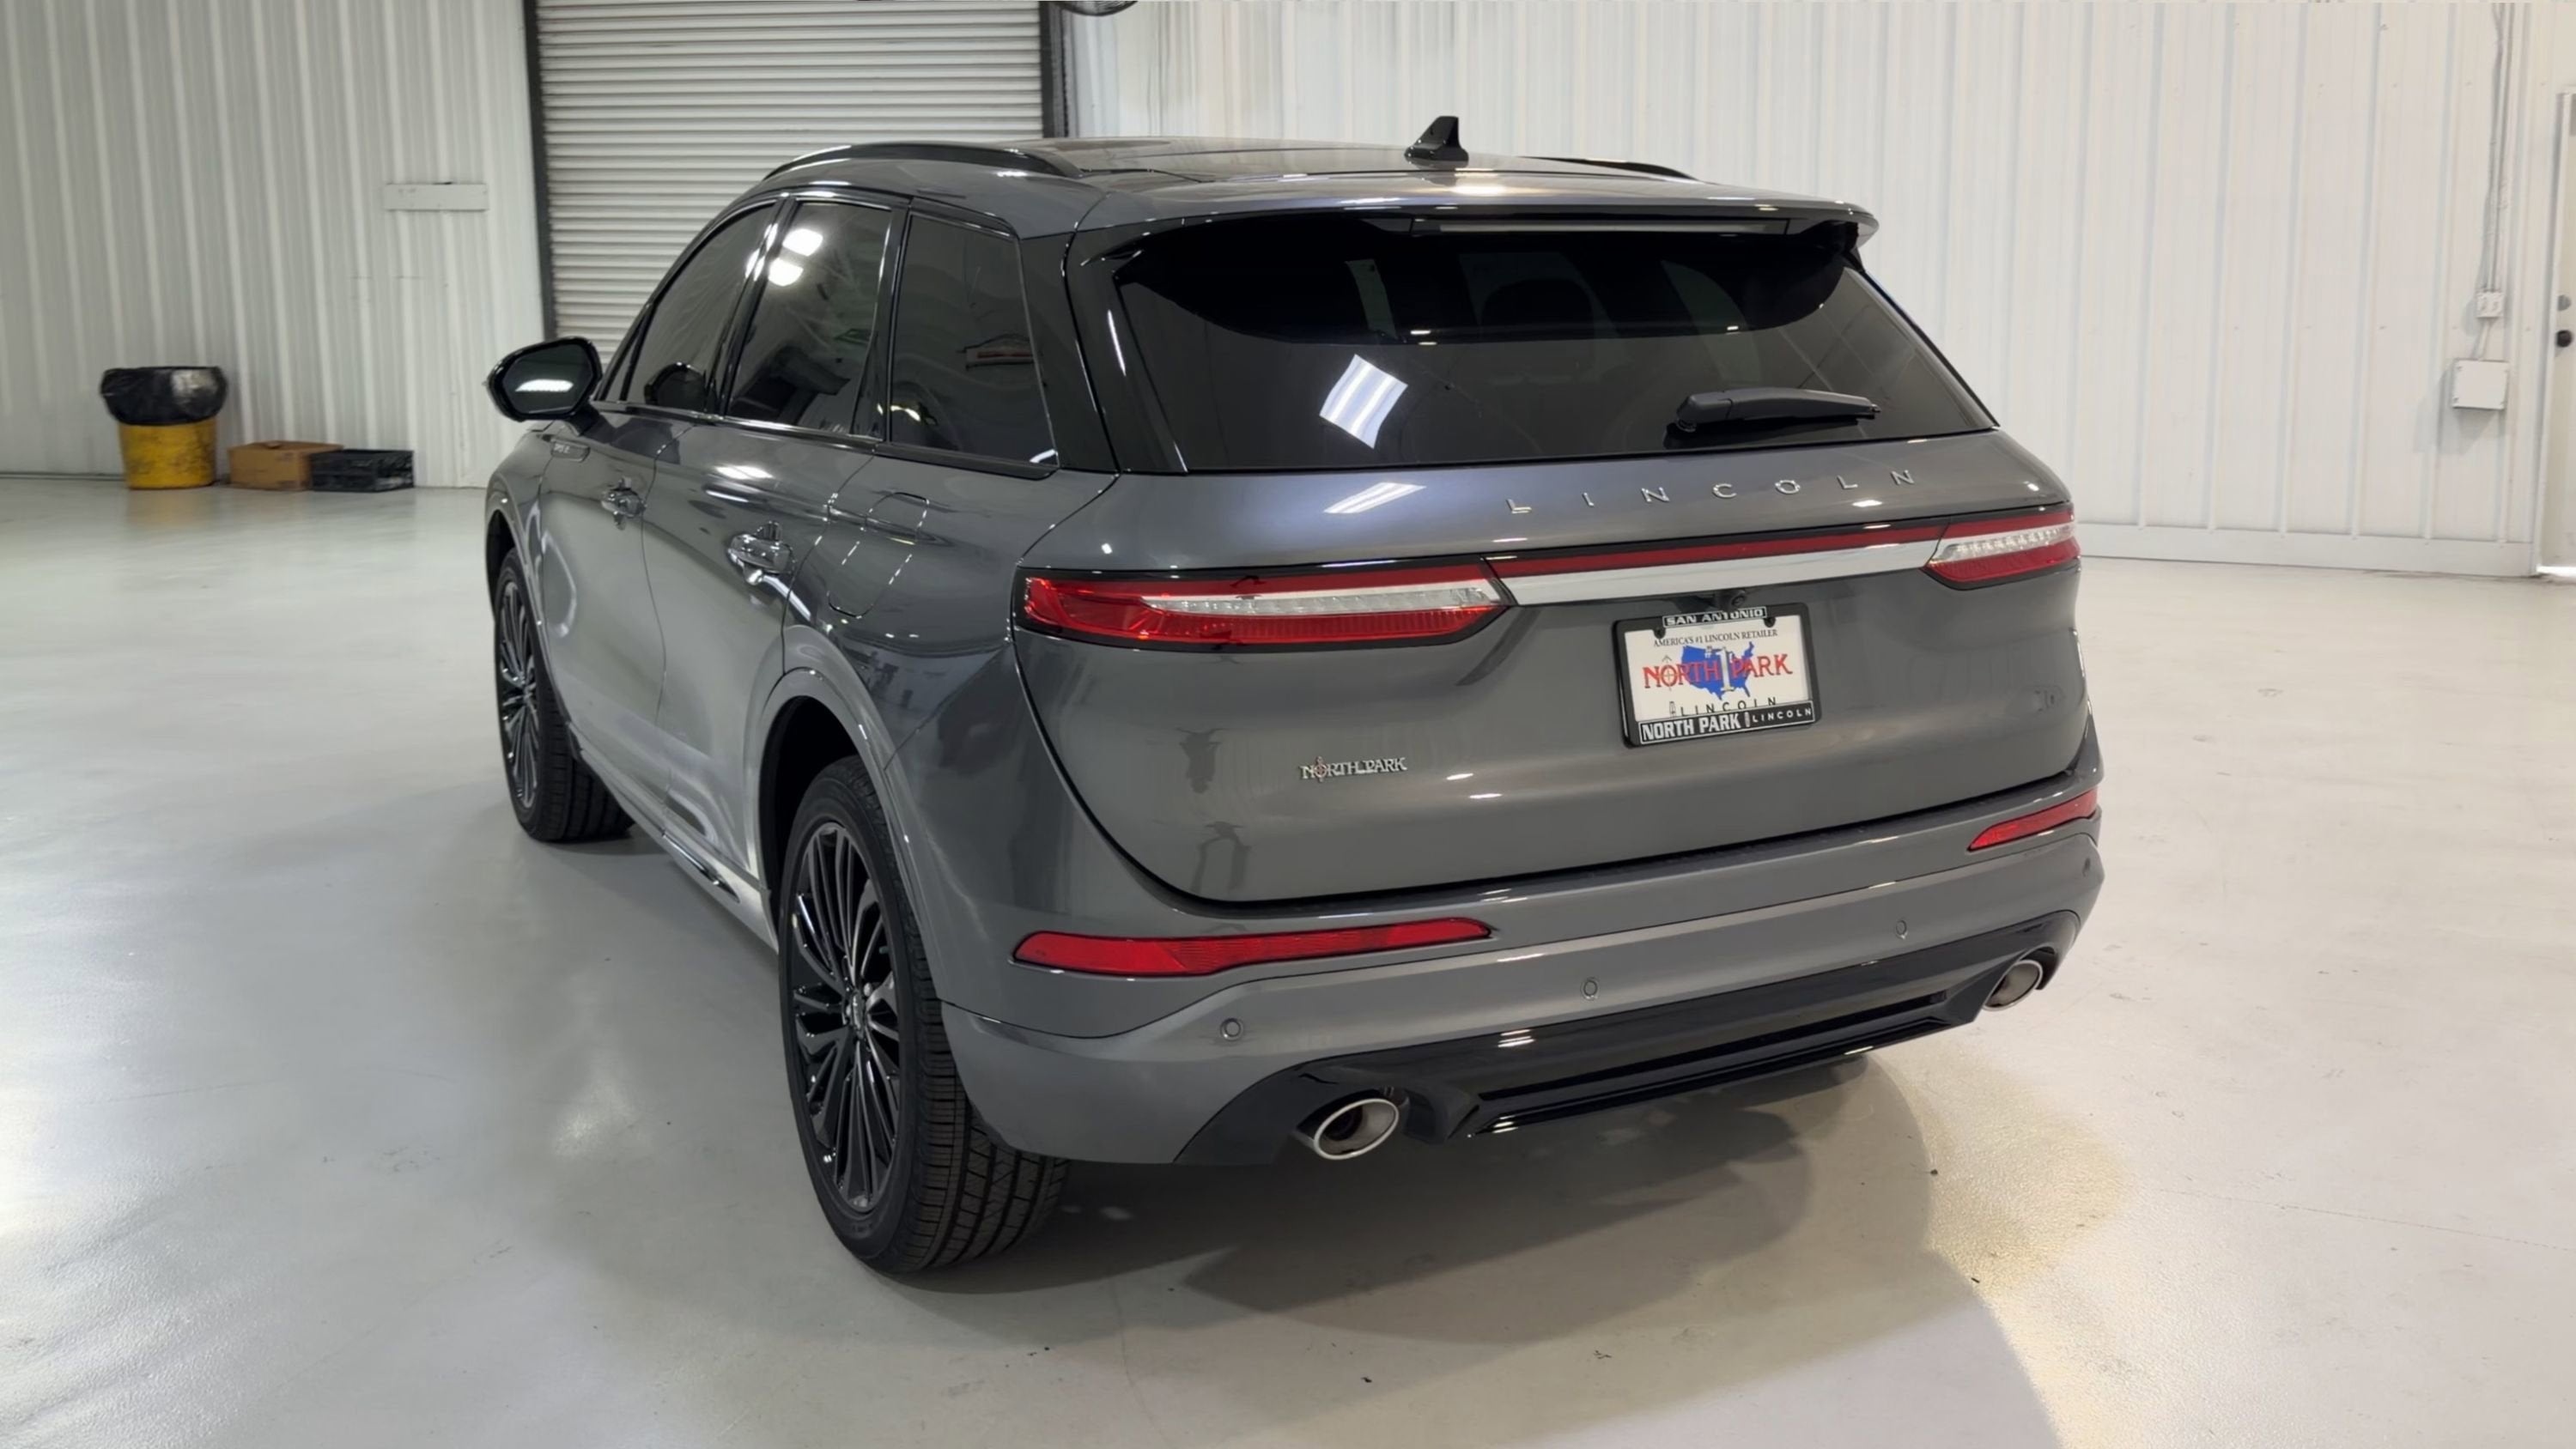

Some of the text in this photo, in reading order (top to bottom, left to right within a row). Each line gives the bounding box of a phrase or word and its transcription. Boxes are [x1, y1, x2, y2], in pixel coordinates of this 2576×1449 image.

[1507, 468, 1916, 515] LINCOLN
[1666, 609, 1765, 627] SAN ANTONIO
[1654, 635, 1693, 647] AMERICA'S
[1704, 632, 1741, 643] LINCOLN
[1741, 628, 1778, 640] RETAILER
[1643, 653, 1793, 688] NORTH PARK
[1680, 696, 1777, 716] LINCOLN
[1641, 707, 1812, 742] NORTH PARK LINCOLN
